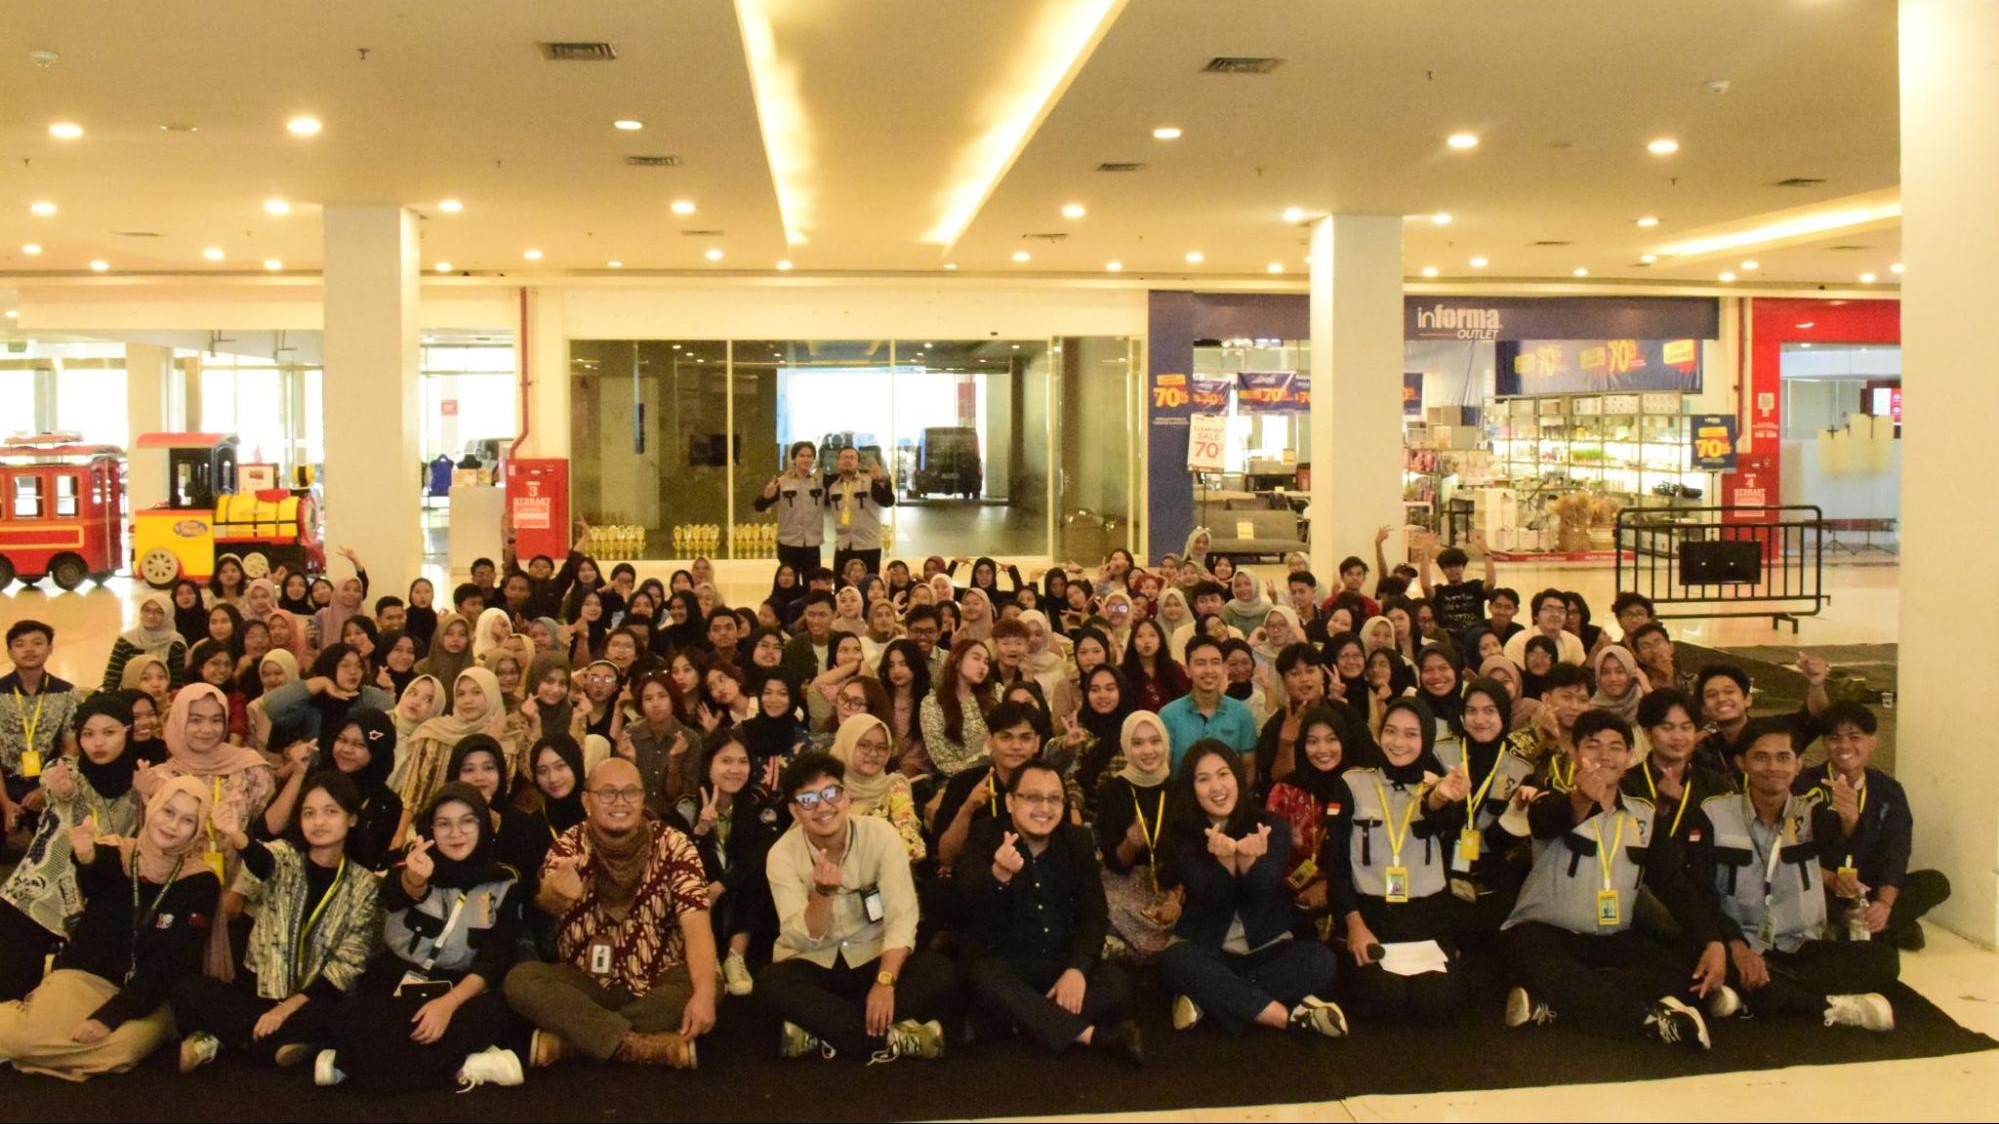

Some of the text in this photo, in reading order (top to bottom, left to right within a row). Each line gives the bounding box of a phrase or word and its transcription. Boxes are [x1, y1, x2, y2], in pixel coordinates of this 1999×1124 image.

[1417, 304, 1500, 329] informa
[1457, 329, 1499, 340] OUTLET
[1197, 432, 1219, 440] SALE
[529, 485, 538, 497] 3
